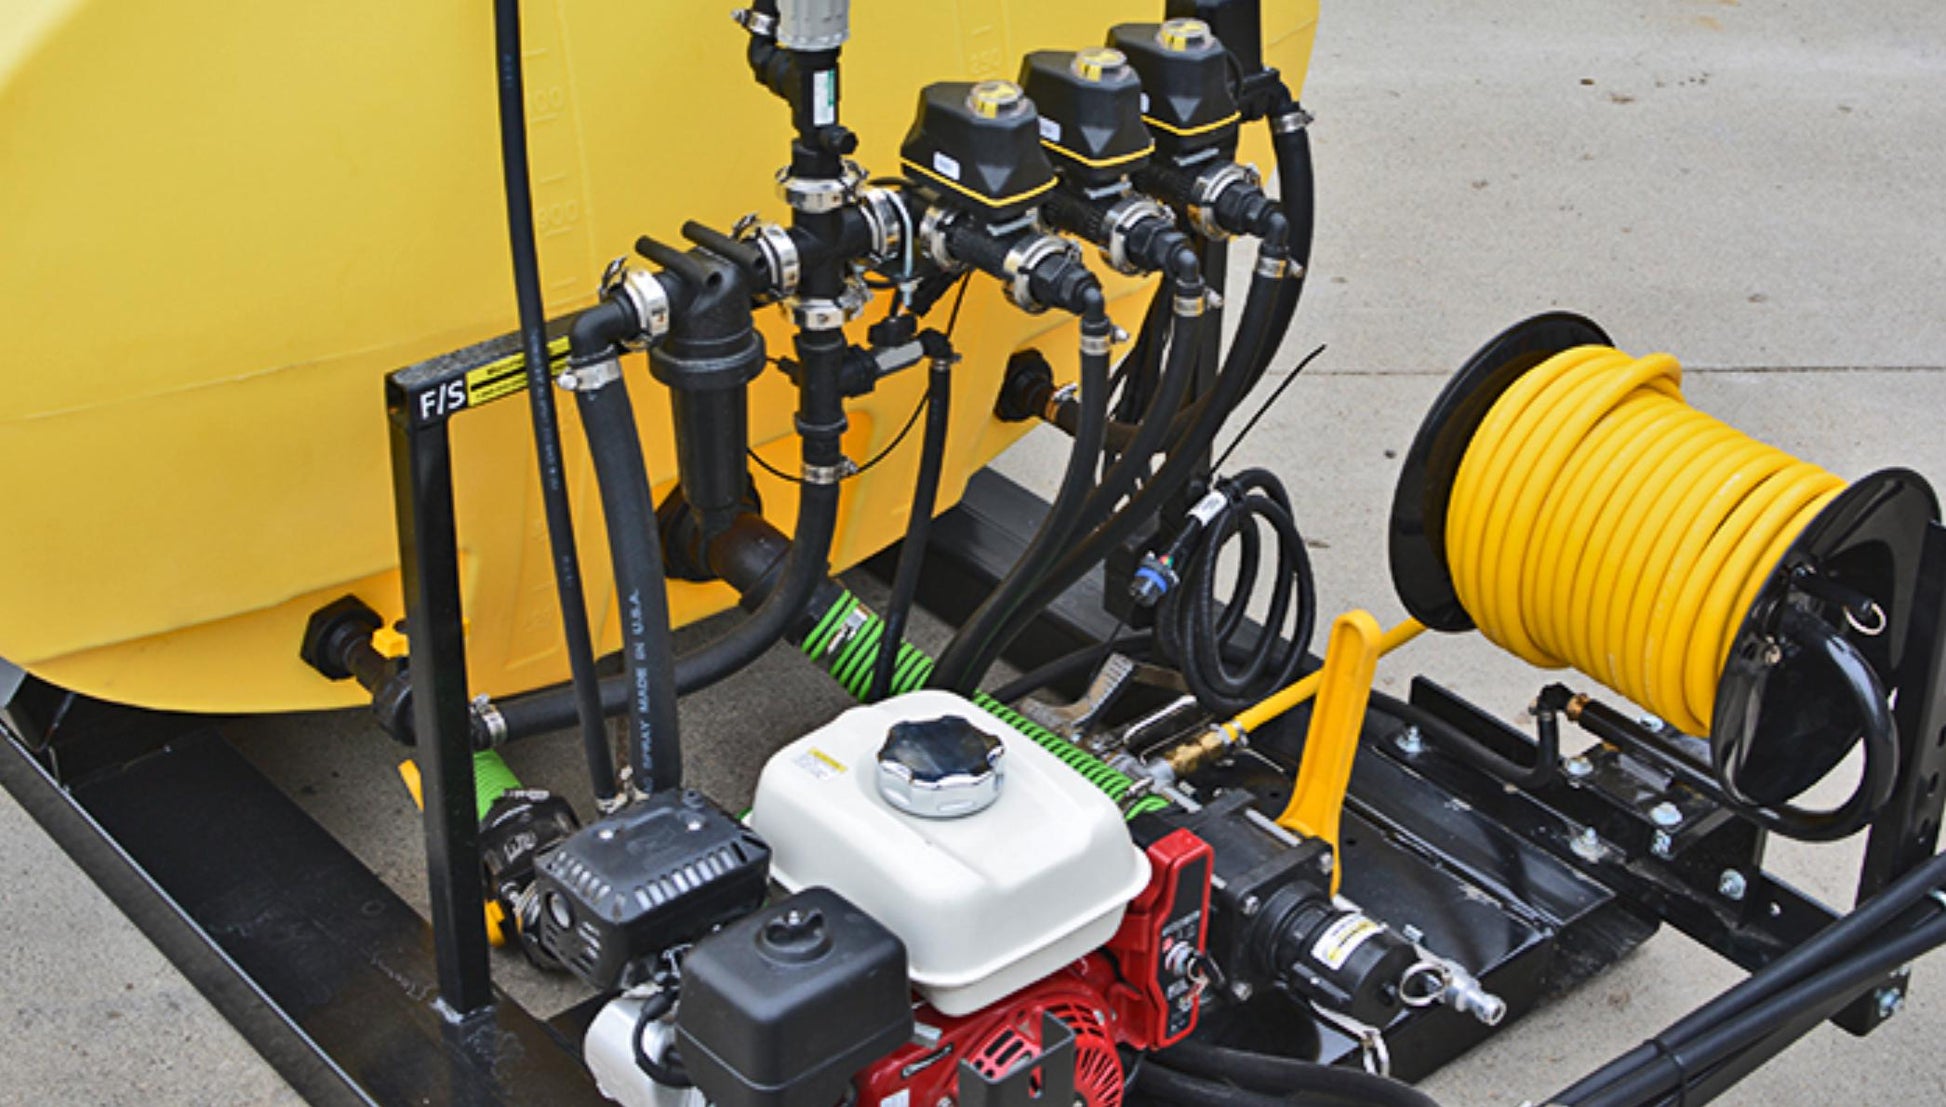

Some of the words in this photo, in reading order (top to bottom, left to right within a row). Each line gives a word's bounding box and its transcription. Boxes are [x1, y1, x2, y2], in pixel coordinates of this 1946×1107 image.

[419, 379, 466, 420] F/S
[634, 642, 646, 660] IN
[635, 667, 649, 713] MADE
[640, 720, 653, 769] SPRAY
